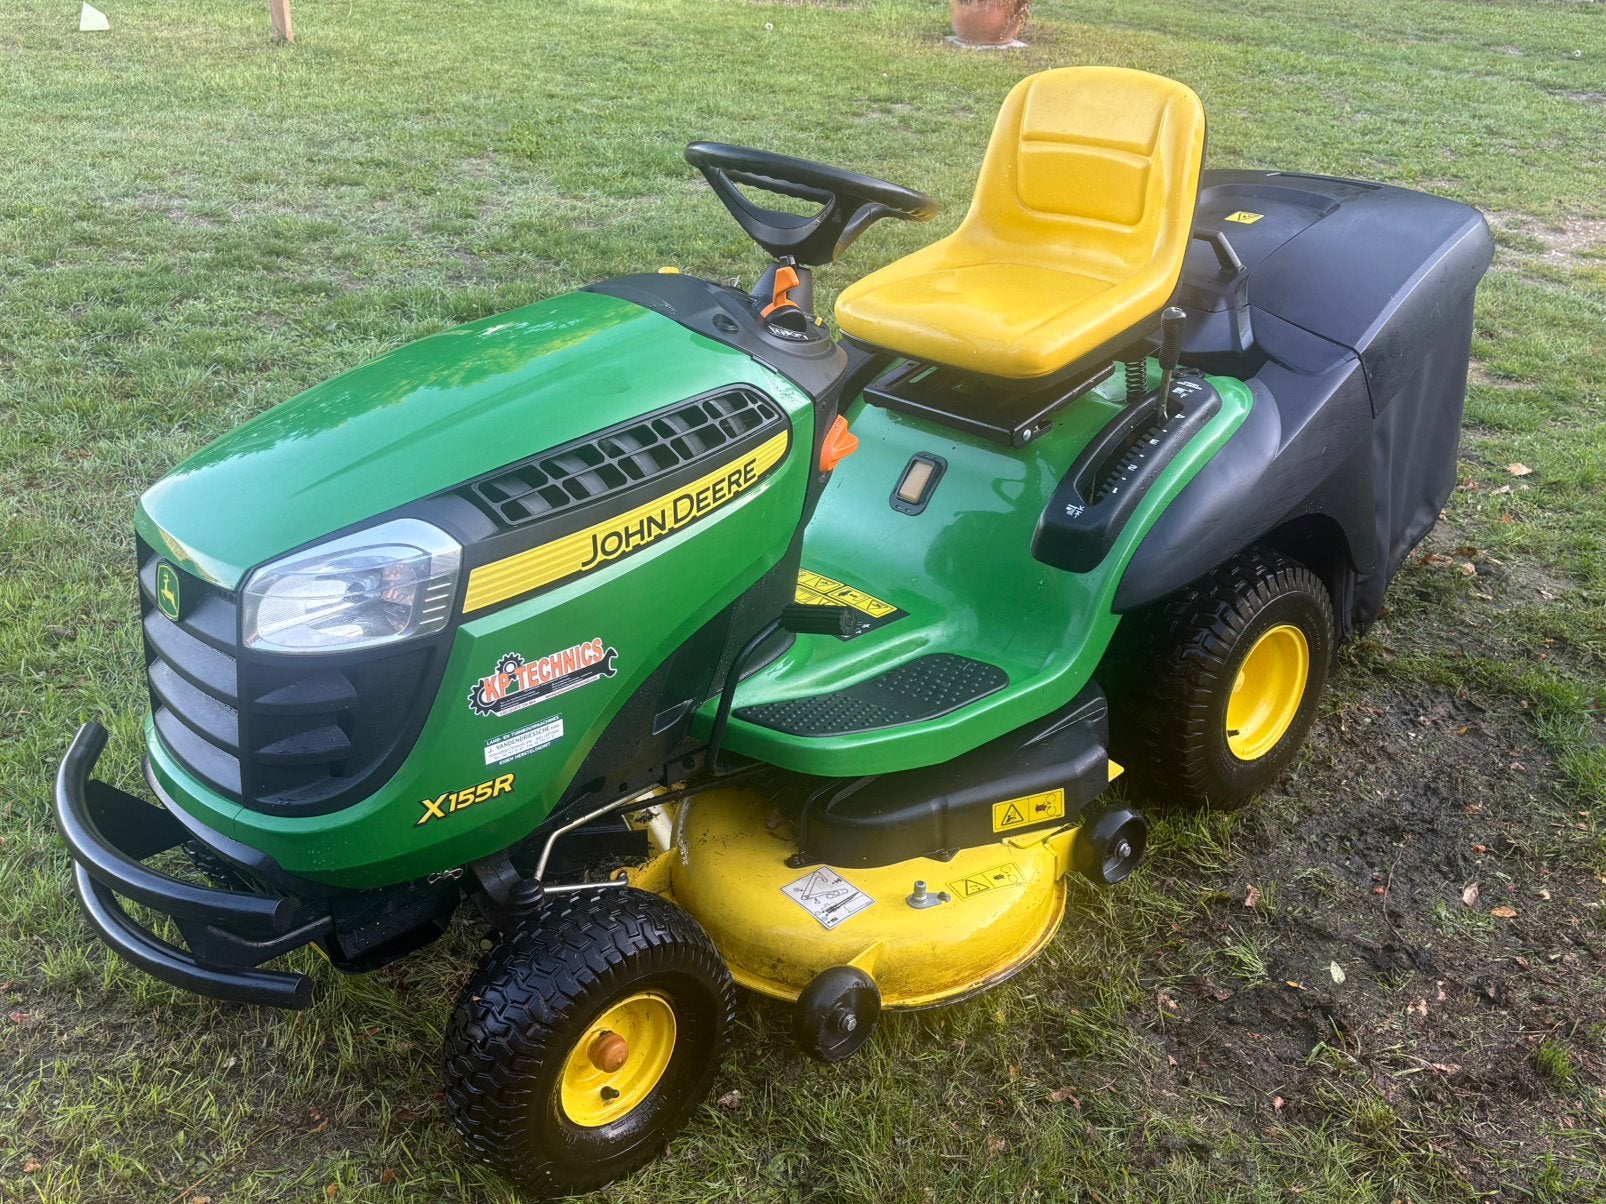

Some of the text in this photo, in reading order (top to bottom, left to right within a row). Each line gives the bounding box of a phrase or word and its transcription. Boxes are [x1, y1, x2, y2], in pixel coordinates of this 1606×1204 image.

[581, 458, 757, 568] JOHN DEERE
[483, 671, 511, 703] KP
[514, 637, 605, 691] TECHNICS
[415, 772, 515, 825] X155R
